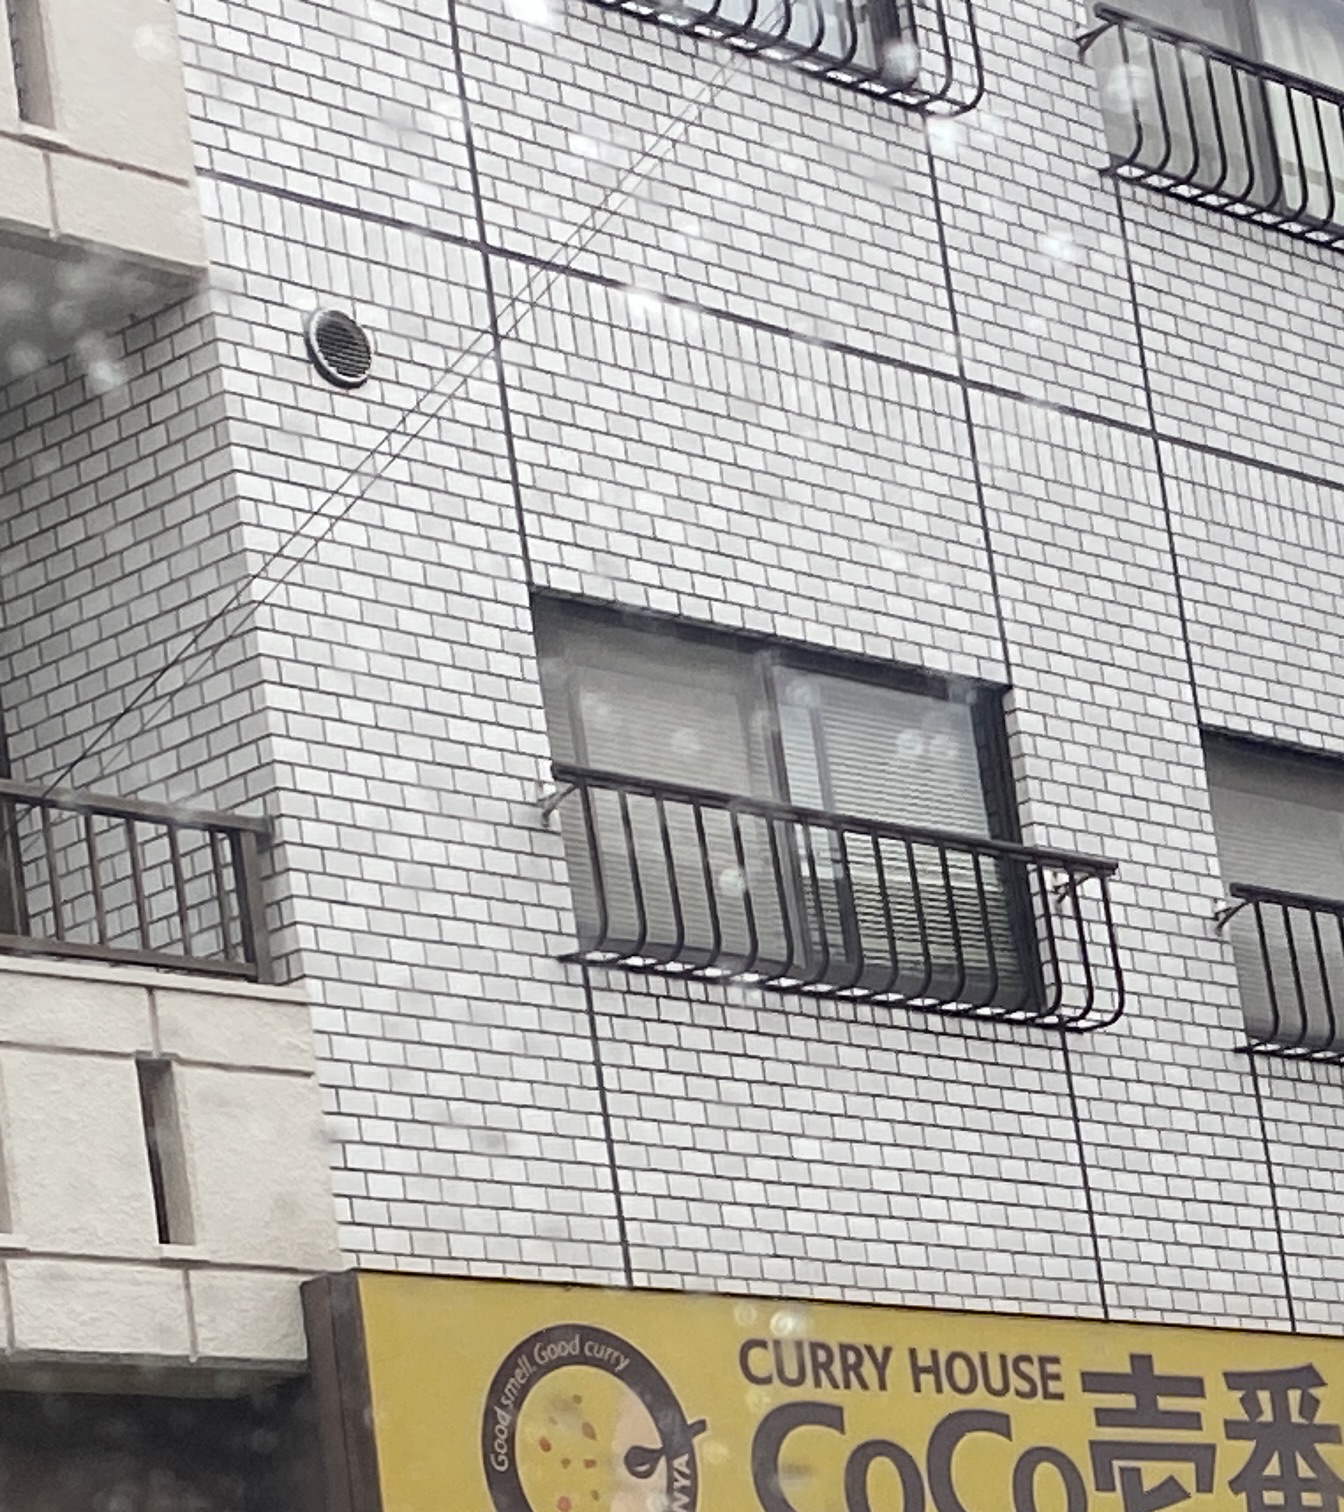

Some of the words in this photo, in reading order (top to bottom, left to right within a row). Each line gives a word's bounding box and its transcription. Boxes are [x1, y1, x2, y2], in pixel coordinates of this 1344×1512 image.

[490, 1405, 511, 1473] Good
[534, 1334, 581, 1366] Good
[584, 1340, 631, 1372] curry
[740, 1337, 893, 1394] CURRY
[909, 1347, 1064, 1401] HOUSE
